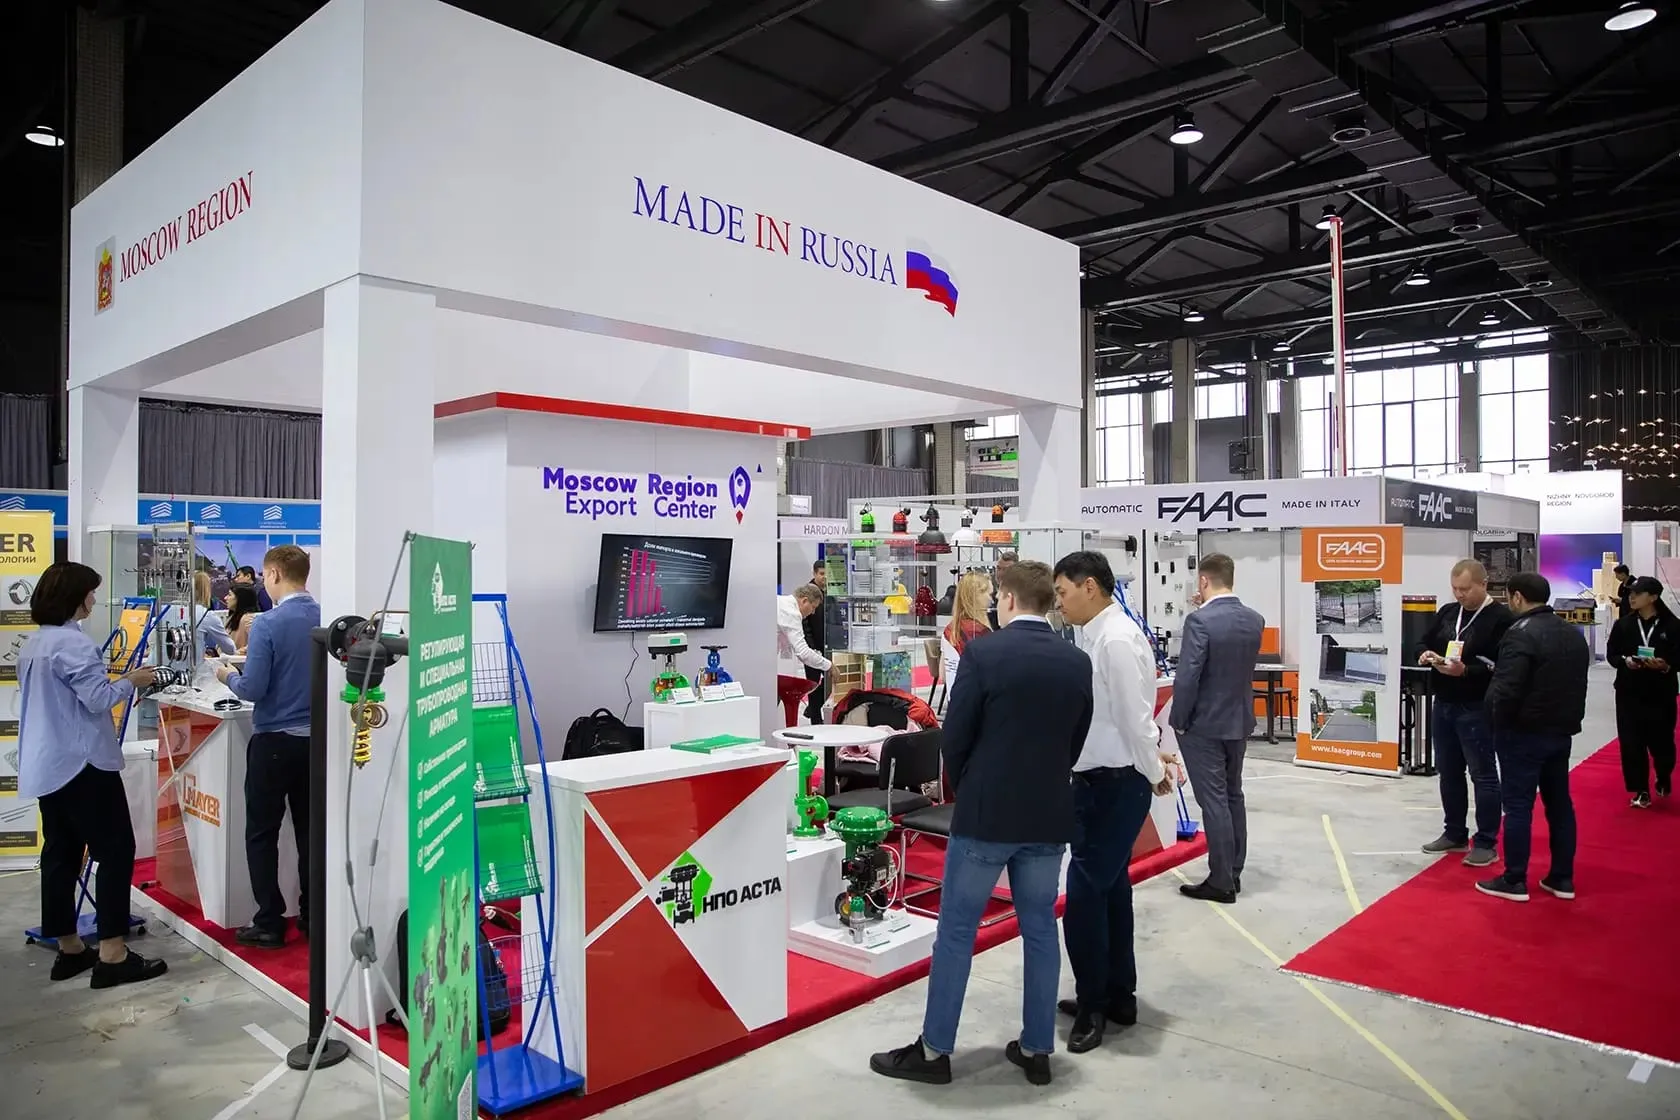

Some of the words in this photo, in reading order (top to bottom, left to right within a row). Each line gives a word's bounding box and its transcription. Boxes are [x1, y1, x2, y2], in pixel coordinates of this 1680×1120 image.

[120, 215, 182, 282] MOSCOW
[186, 171, 253, 244] REGION
[632, 176, 745, 243] MADE
[755, 213, 791, 256] IN
[800, 226, 898, 286] RUSSIA
[543, 467, 638, 493] Moscow
[648, 473, 718, 502] Region
[566, 492, 638, 520] Export
[654, 497, 717, 519] Center
[1081, 504, 1143, 514] AUTOMATIC
[1157, 491, 1267, 523] FAAC
[1281, 501, 1312, 509] MADE
[1315, 500, 1327, 508] IN
[1330, 499, 1361, 508] ITALY
[1418, 491, 1453, 522] FAAC
[804, 524, 840, 536] HARDON
[1326, 541, 1377, 555] FAAC
[1311, 745, 1383, 759] www.faacgroup.com
[702, 889, 738, 914] НПО
[740, 876, 782, 903] АСТА
